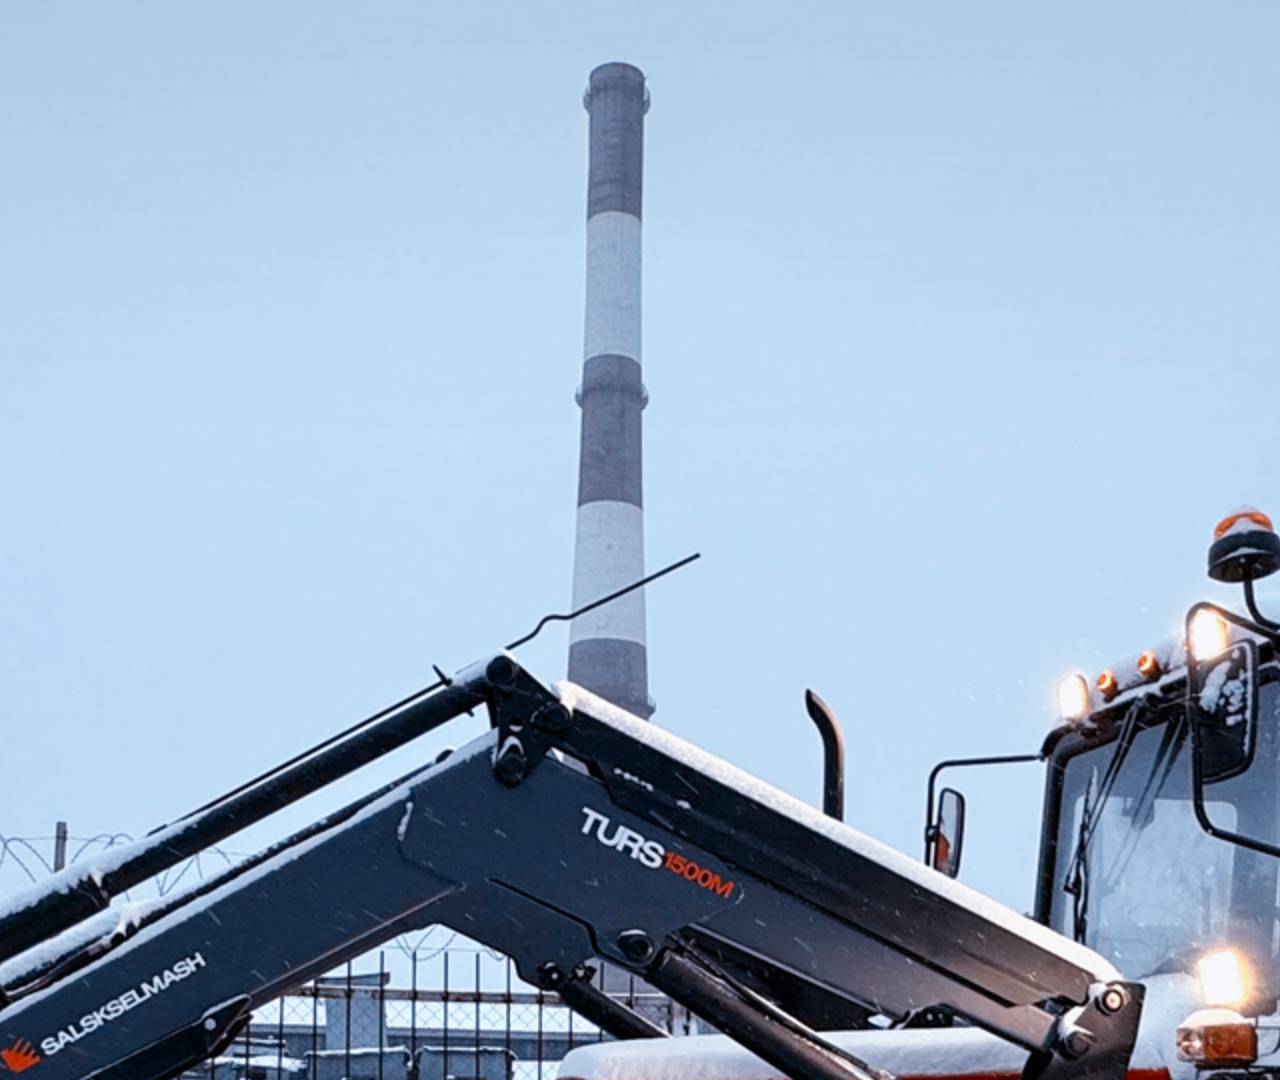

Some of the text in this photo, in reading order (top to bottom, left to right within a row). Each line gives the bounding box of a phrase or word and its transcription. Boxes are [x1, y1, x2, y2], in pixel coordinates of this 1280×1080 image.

[581, 806, 735, 899] TURS 1500M
[40, 951, 207, 1056] SALSKSELMASH
